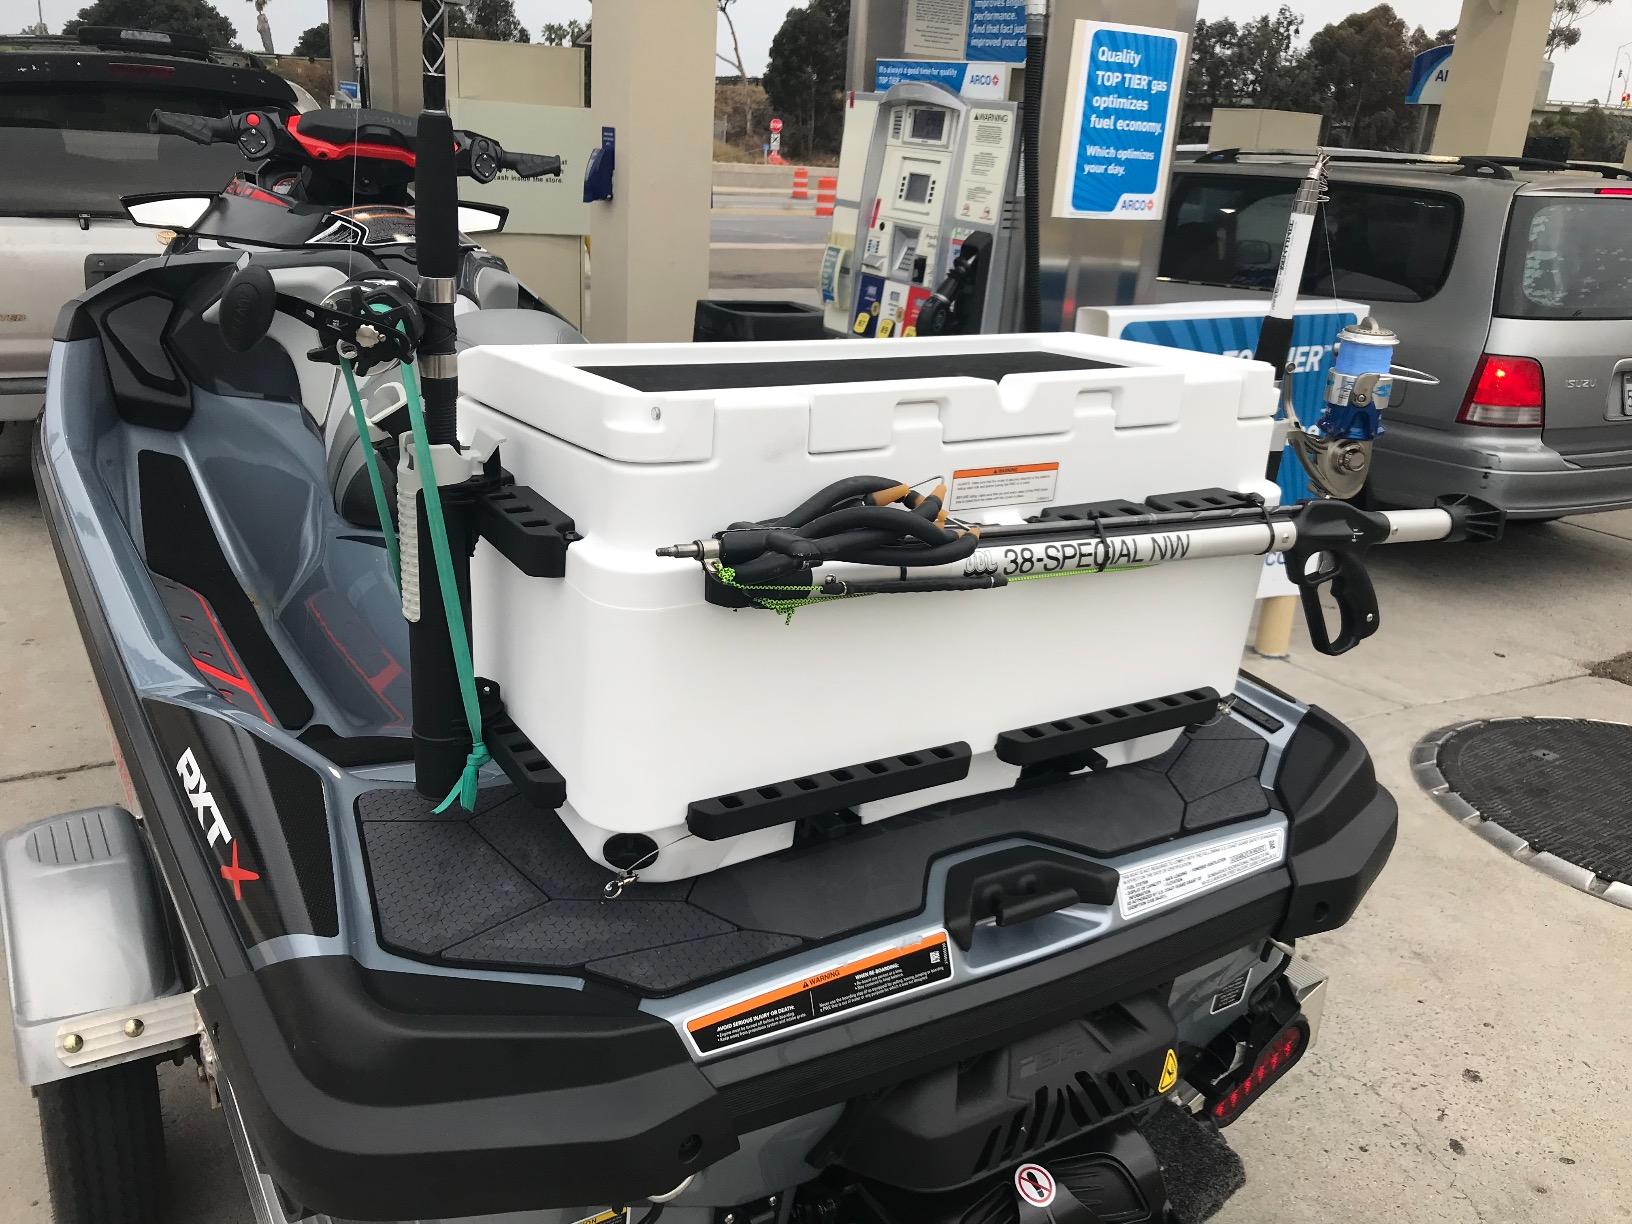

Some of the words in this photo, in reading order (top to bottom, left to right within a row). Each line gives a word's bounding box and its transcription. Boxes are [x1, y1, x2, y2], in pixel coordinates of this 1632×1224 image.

[972, 24, 986, 33] And
[971, 37, 1001, 48] improved
[1098, 46, 1141, 67] Quality
[970, 75, 991, 85] ARCO
[1096, 71, 1122, 86] TOP
[1151, 80, 1167, 93] gas
[1092, 94, 1149, 111] optimizes
[1090, 114, 1115, 129] fuel
[1116, 119, 1162, 135] economy.
[1086, 145, 1116, 158] Which
[1117, 148, 1154, 161] optimizes
[1083, 164, 1106, 175] your
[1107, 163, 1125, 176] day.
[1121, 200, 1146, 210] ARCO
[1003, 535, 1145, 577] 38-SPECIAL
[1150, 533, 1191, 561] NW
[810, 970, 840, 986] WARNING
[717, 1023, 733, 1032] AVOID
[733, 1016, 753, 1027] SERIOUS
